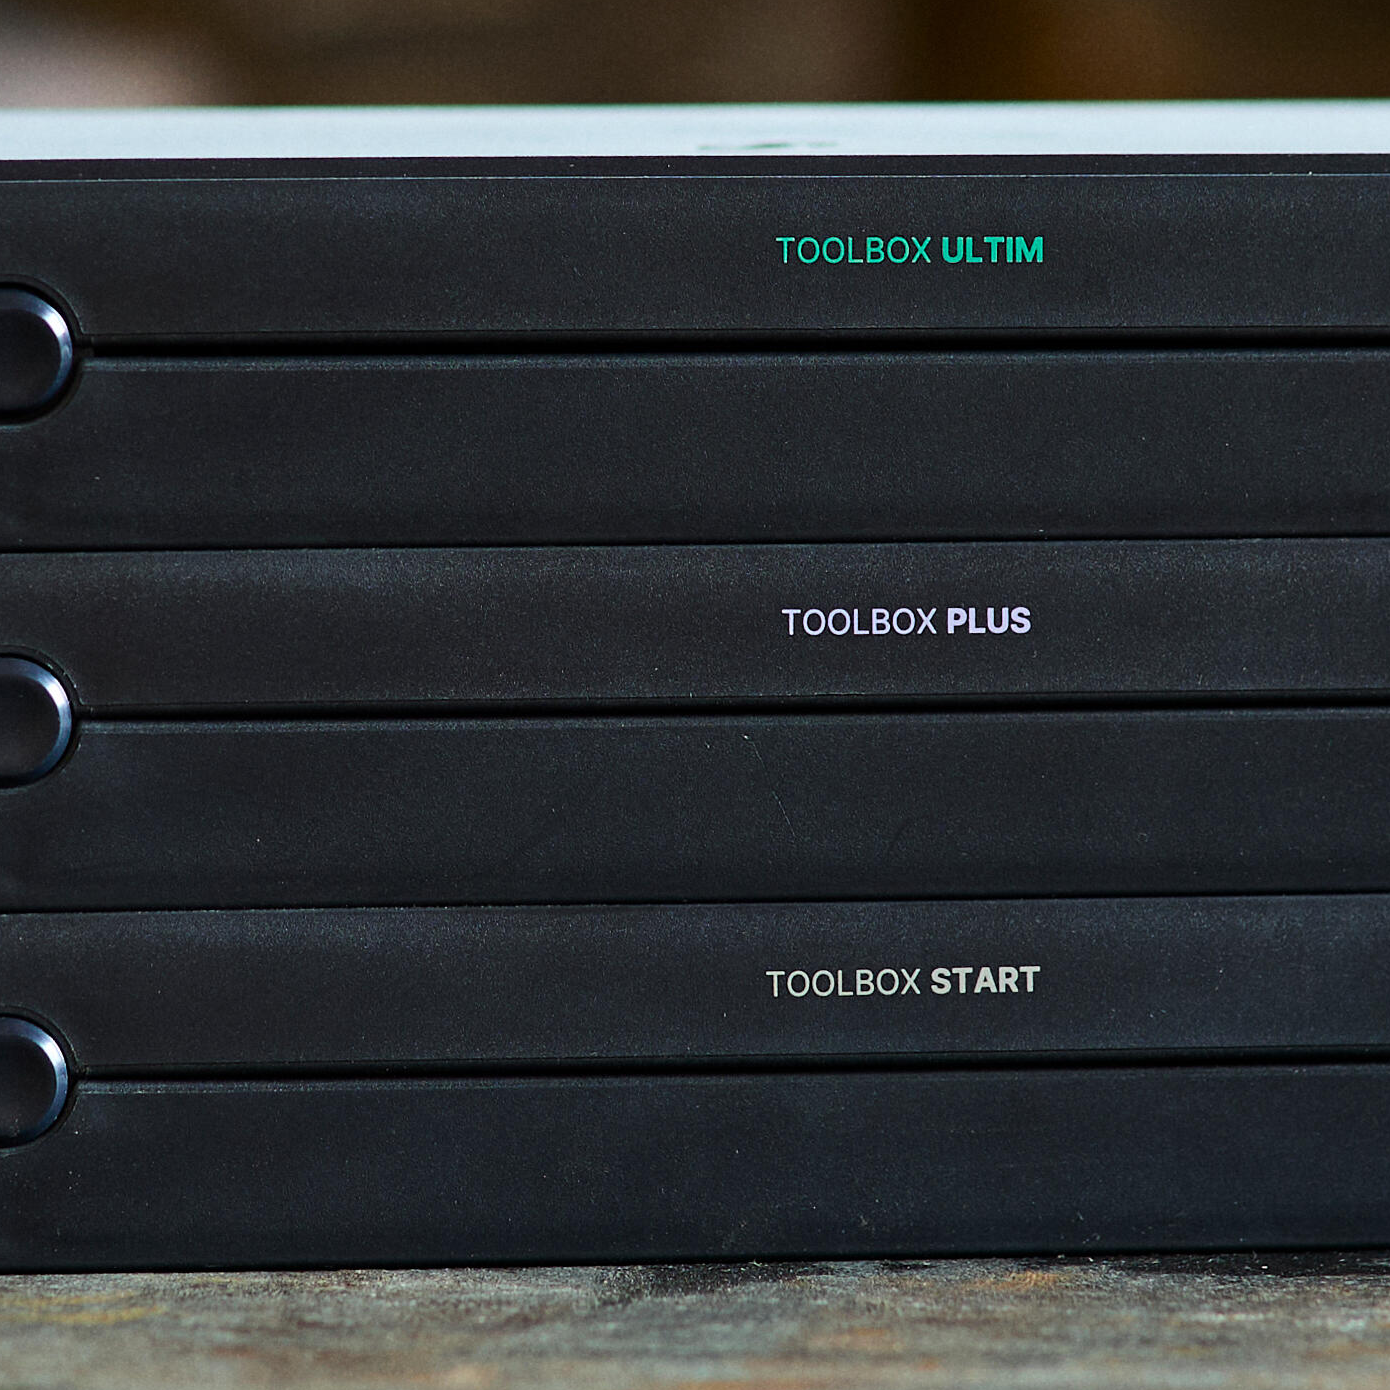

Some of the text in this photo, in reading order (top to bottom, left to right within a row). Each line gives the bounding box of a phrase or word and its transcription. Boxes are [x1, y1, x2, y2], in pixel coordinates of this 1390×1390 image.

[775, 236, 1043, 263] TOOLBOX ULTIM
[781, 607, 1031, 635] TOOLBOX PLUS
[765, 965, 1040, 997] TOOLBOX START
